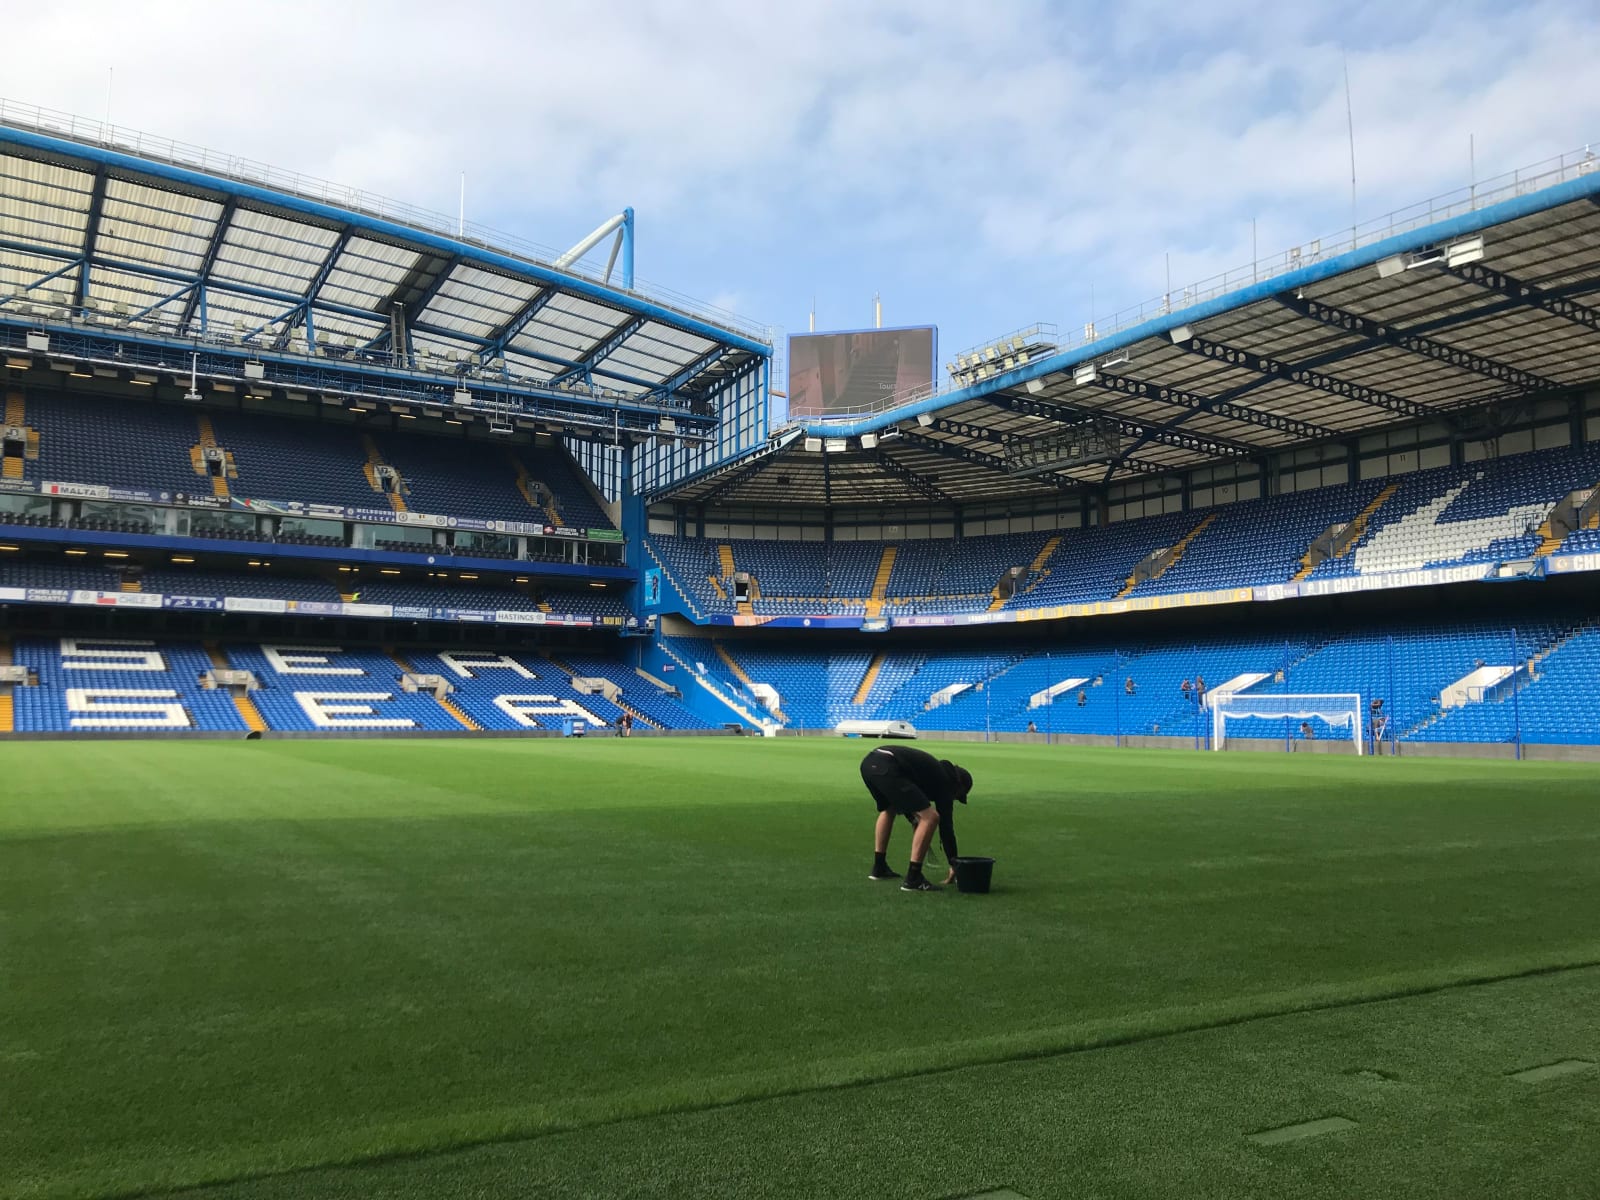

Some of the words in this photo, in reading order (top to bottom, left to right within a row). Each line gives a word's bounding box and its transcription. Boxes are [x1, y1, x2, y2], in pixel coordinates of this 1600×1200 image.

[61, 487, 97, 496] MALTA
[356, 514, 396, 523] CHELSEA
[1334, 574, 1382, 592] CAPTAIN
[394, 606, 429, 614] AMERICAN
[498, 613, 535, 622] HASTINGS
